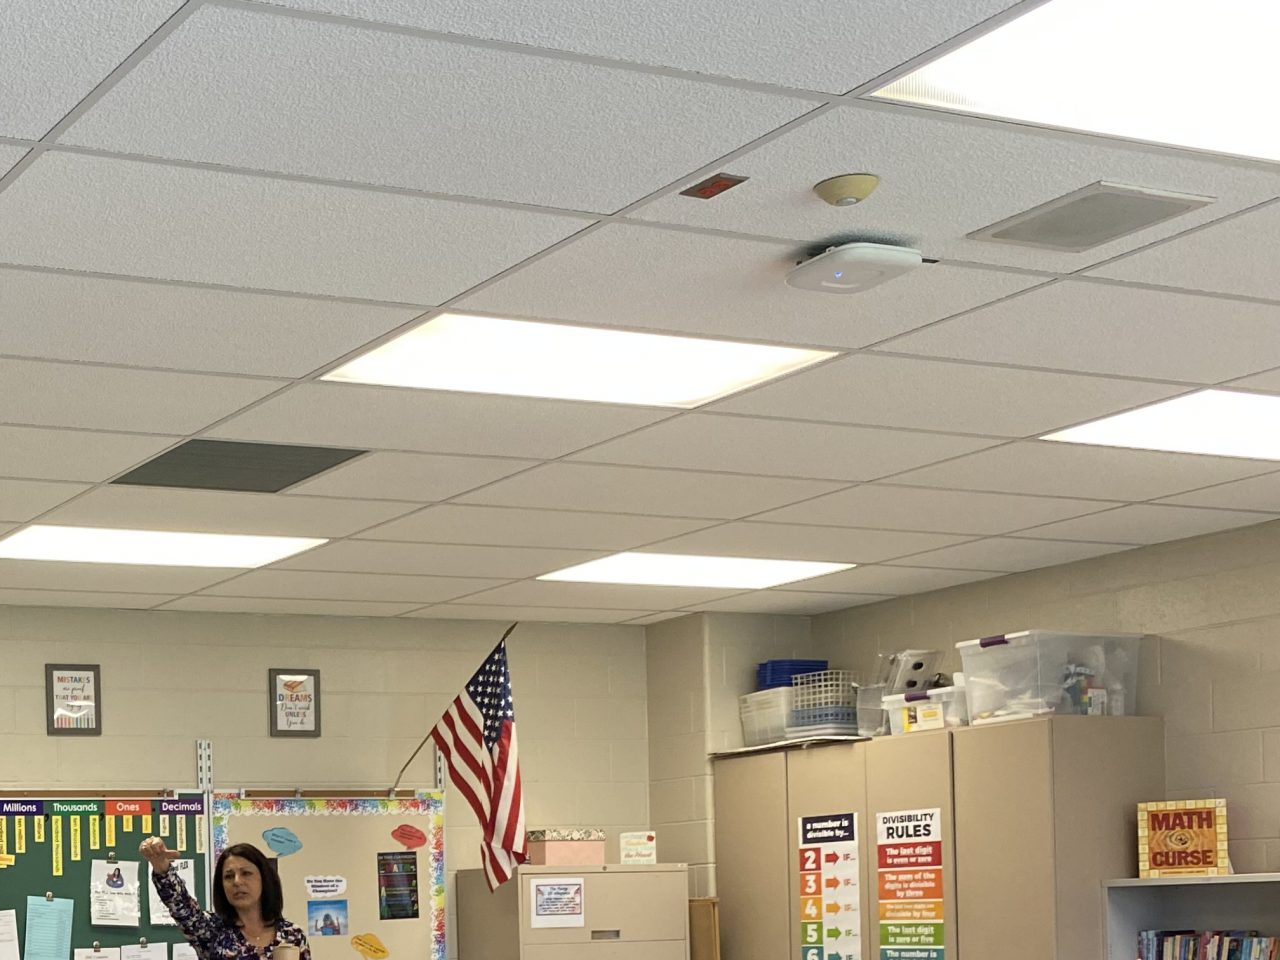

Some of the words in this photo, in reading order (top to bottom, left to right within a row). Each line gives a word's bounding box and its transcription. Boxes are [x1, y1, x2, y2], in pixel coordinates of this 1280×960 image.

[278, 694, 312, 702] DREAMS
[3, 803, 36, 812] Millions
[53, 803, 97, 811] Thousands
[117, 803, 139, 811] Ones
[162, 802, 201, 811] Decimals
[813, 820, 841, 829] number
[842, 818, 848, 826] is
[883, 813, 934, 824] DIVISIBILITY
[1151, 811, 1212, 831] MATH
[806, 829, 834, 839] divisible
[886, 824, 931, 839] RULES
[900, 847, 913, 855] last
[915, 846, 932, 854] digit
[804, 851, 816, 869] 2
[1151, 850, 1213, 867] CURSE
[805, 875, 816, 893] 3
[805, 899, 817, 918] 4
[806, 924, 818, 942] 5
[917, 926, 934, 934] digit
[901, 950, 929, 958] number
[930, 950, 937, 958] is
